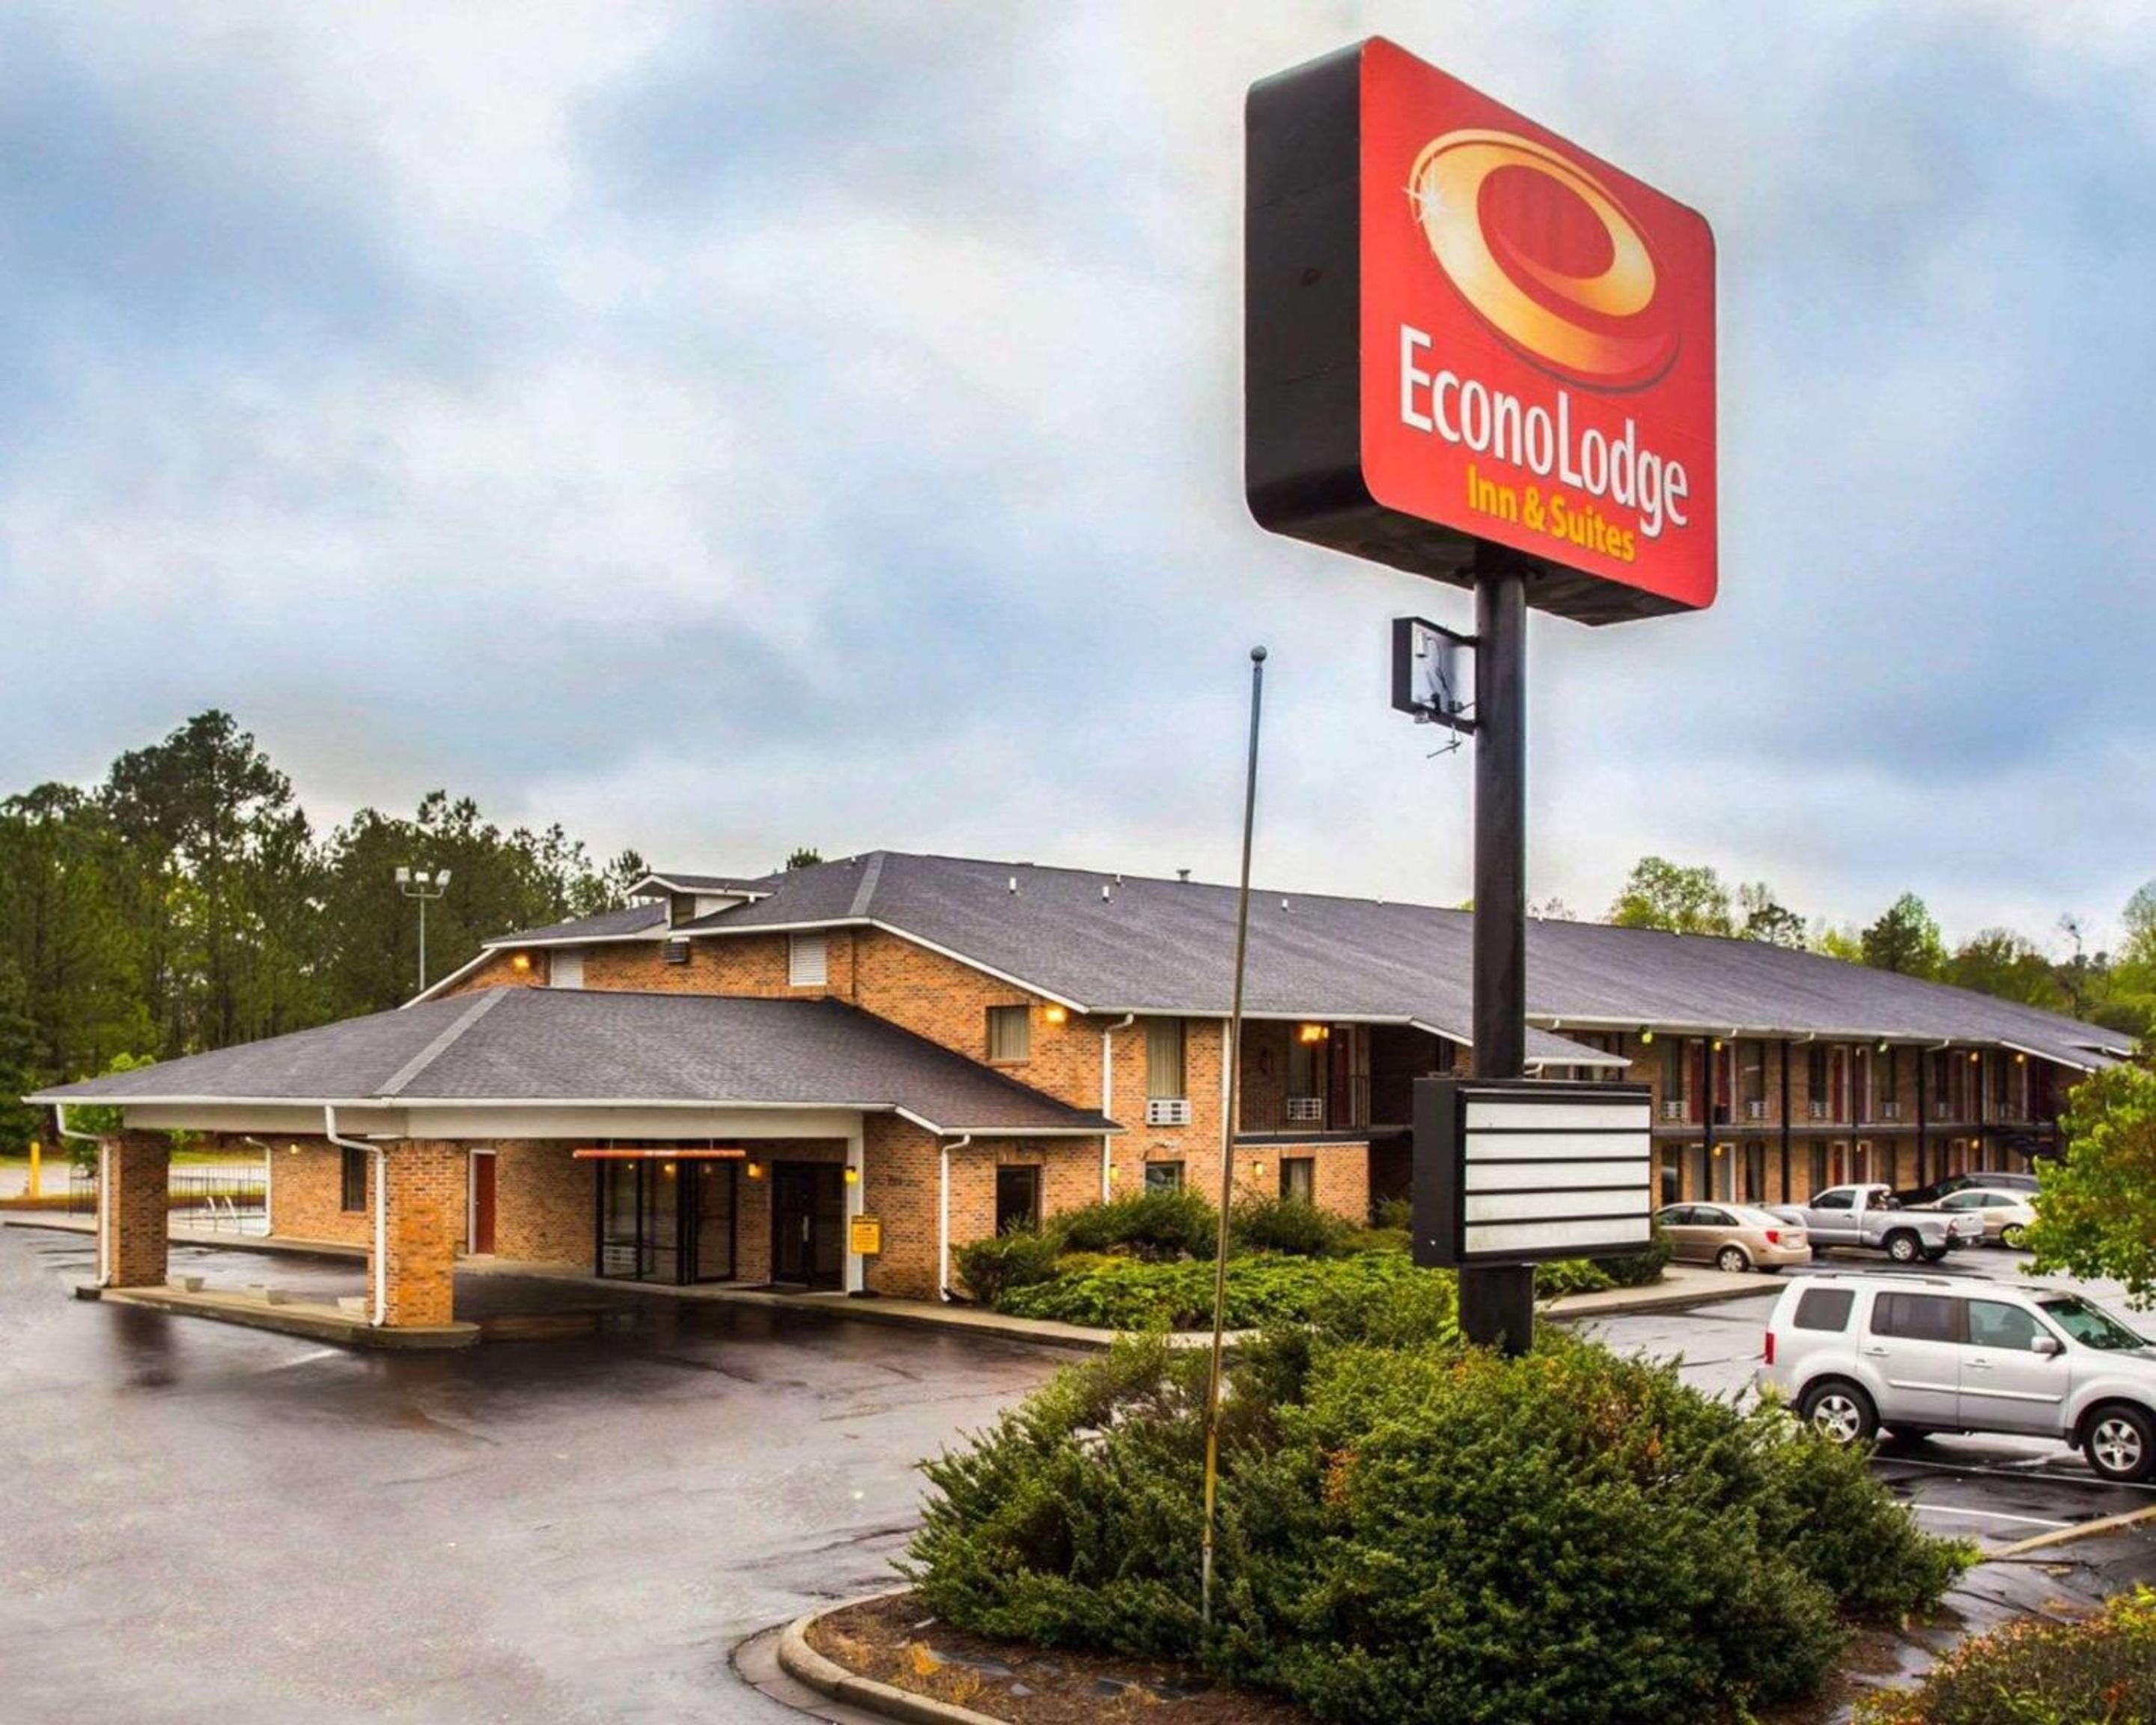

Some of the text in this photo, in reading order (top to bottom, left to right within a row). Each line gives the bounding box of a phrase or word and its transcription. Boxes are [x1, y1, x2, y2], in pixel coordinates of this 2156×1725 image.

[1467, 463, 1635, 562] Inn & Suites
